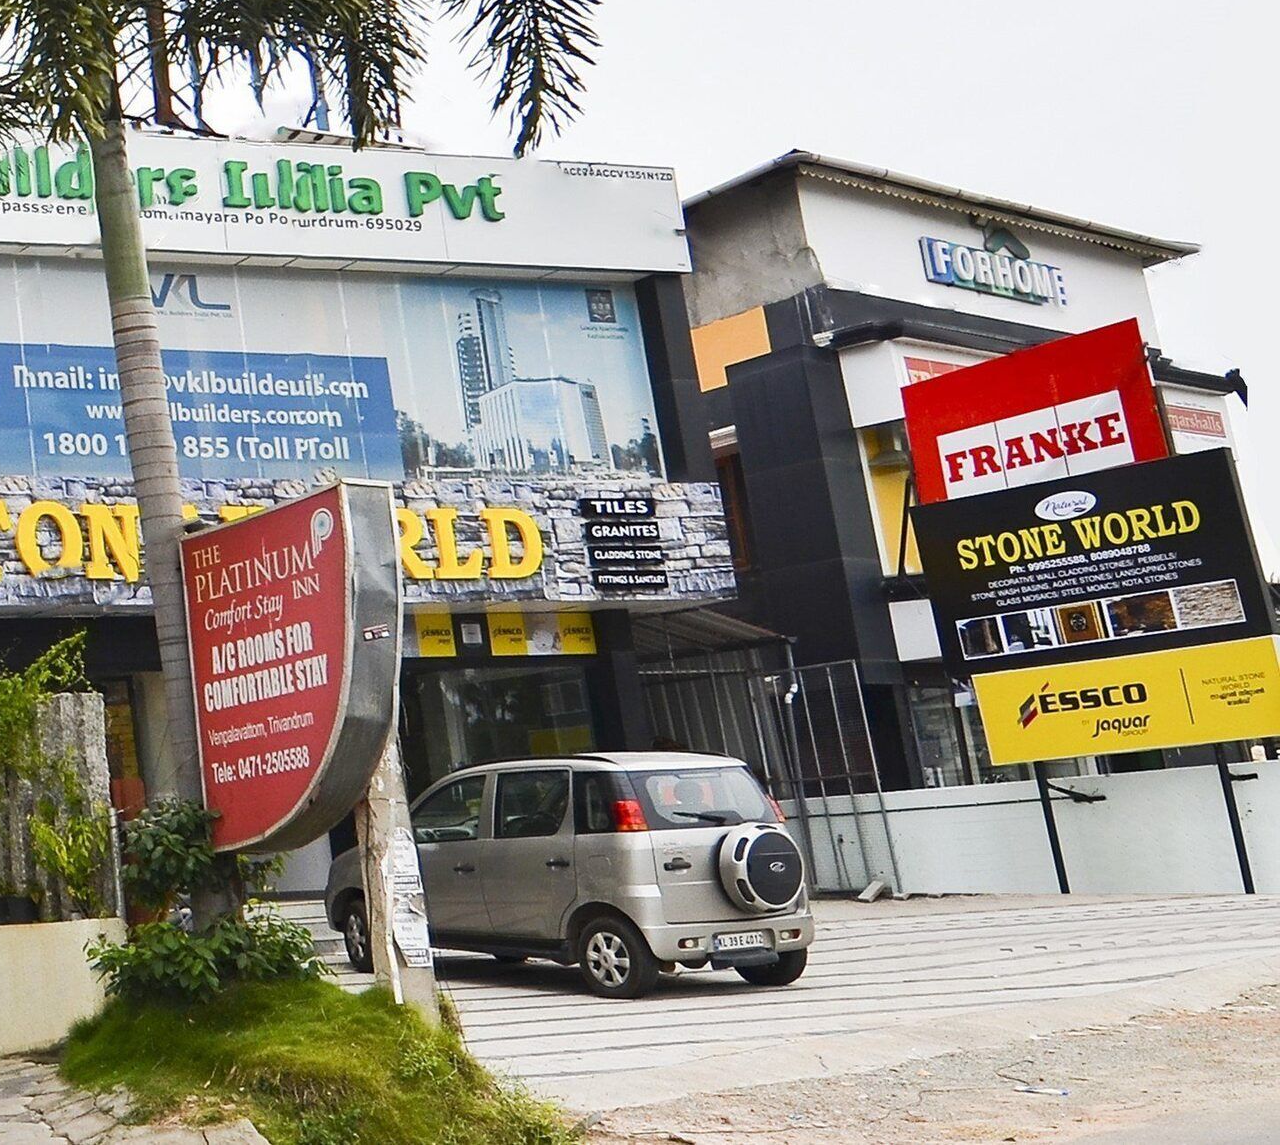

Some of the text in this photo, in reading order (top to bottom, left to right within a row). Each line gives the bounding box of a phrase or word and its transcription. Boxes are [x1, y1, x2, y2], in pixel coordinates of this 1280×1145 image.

[404, 171, 505, 221] Pvt
[1167, 413, 1222, 431] marshalls
[43, 432, 108, 456] 1800
[183, 436, 230, 459] 855
[236, 436, 289, 462] (Toll
[944, 412, 1126, 483] FRANKE
[591, 500, 649, 514] TILES
[1044, 495, 1089, 514] Natural
[591, 525, 658, 538] GRANITES
[956, 499, 1201, 570] STONE WORLD
[192, 545, 221, 570] THE
[594, 550, 662, 560] CLADDING STONE
[194, 540, 315, 604] PLATINUM
[598, 575, 665, 584] FITTINGS & SANITARY
[971, 592, 997, 602] STONE
[997, 587, 1021, 597] WASH
[1052, 578, 1078, 588] AGATE
[1114, 563, 1167, 578] LANSCAPING
[1168, 558, 1202, 570] STONES
[988, 574, 1035, 589] DECORATIVE
[1036, 572, 1058, 581] WALL
[1058, 564, 1098, 578] CLADDING
[1009, 565, 1027, 575] Ph:
[292, 573, 321, 600] INN
[996, 598, 1021, 607] GLASS
[1061, 587, 1086, 597] STEEL
[1122, 578, 1144, 588] KOTA
[1144, 571, 1178, 584] STONES
[205, 594, 284, 635] Comfort Stay
[211, 621, 313, 675] A/C ROOMS FOR
[204, 653, 328, 712] COMFORTABLE STAY
[1201, 671, 1266, 686] NATURAL STONE
[1221, 681, 1250, 691] WORLD
[267, 711, 314, 734] Trivandrum
[211, 745, 310, 784] Tele: 0471-2505588
